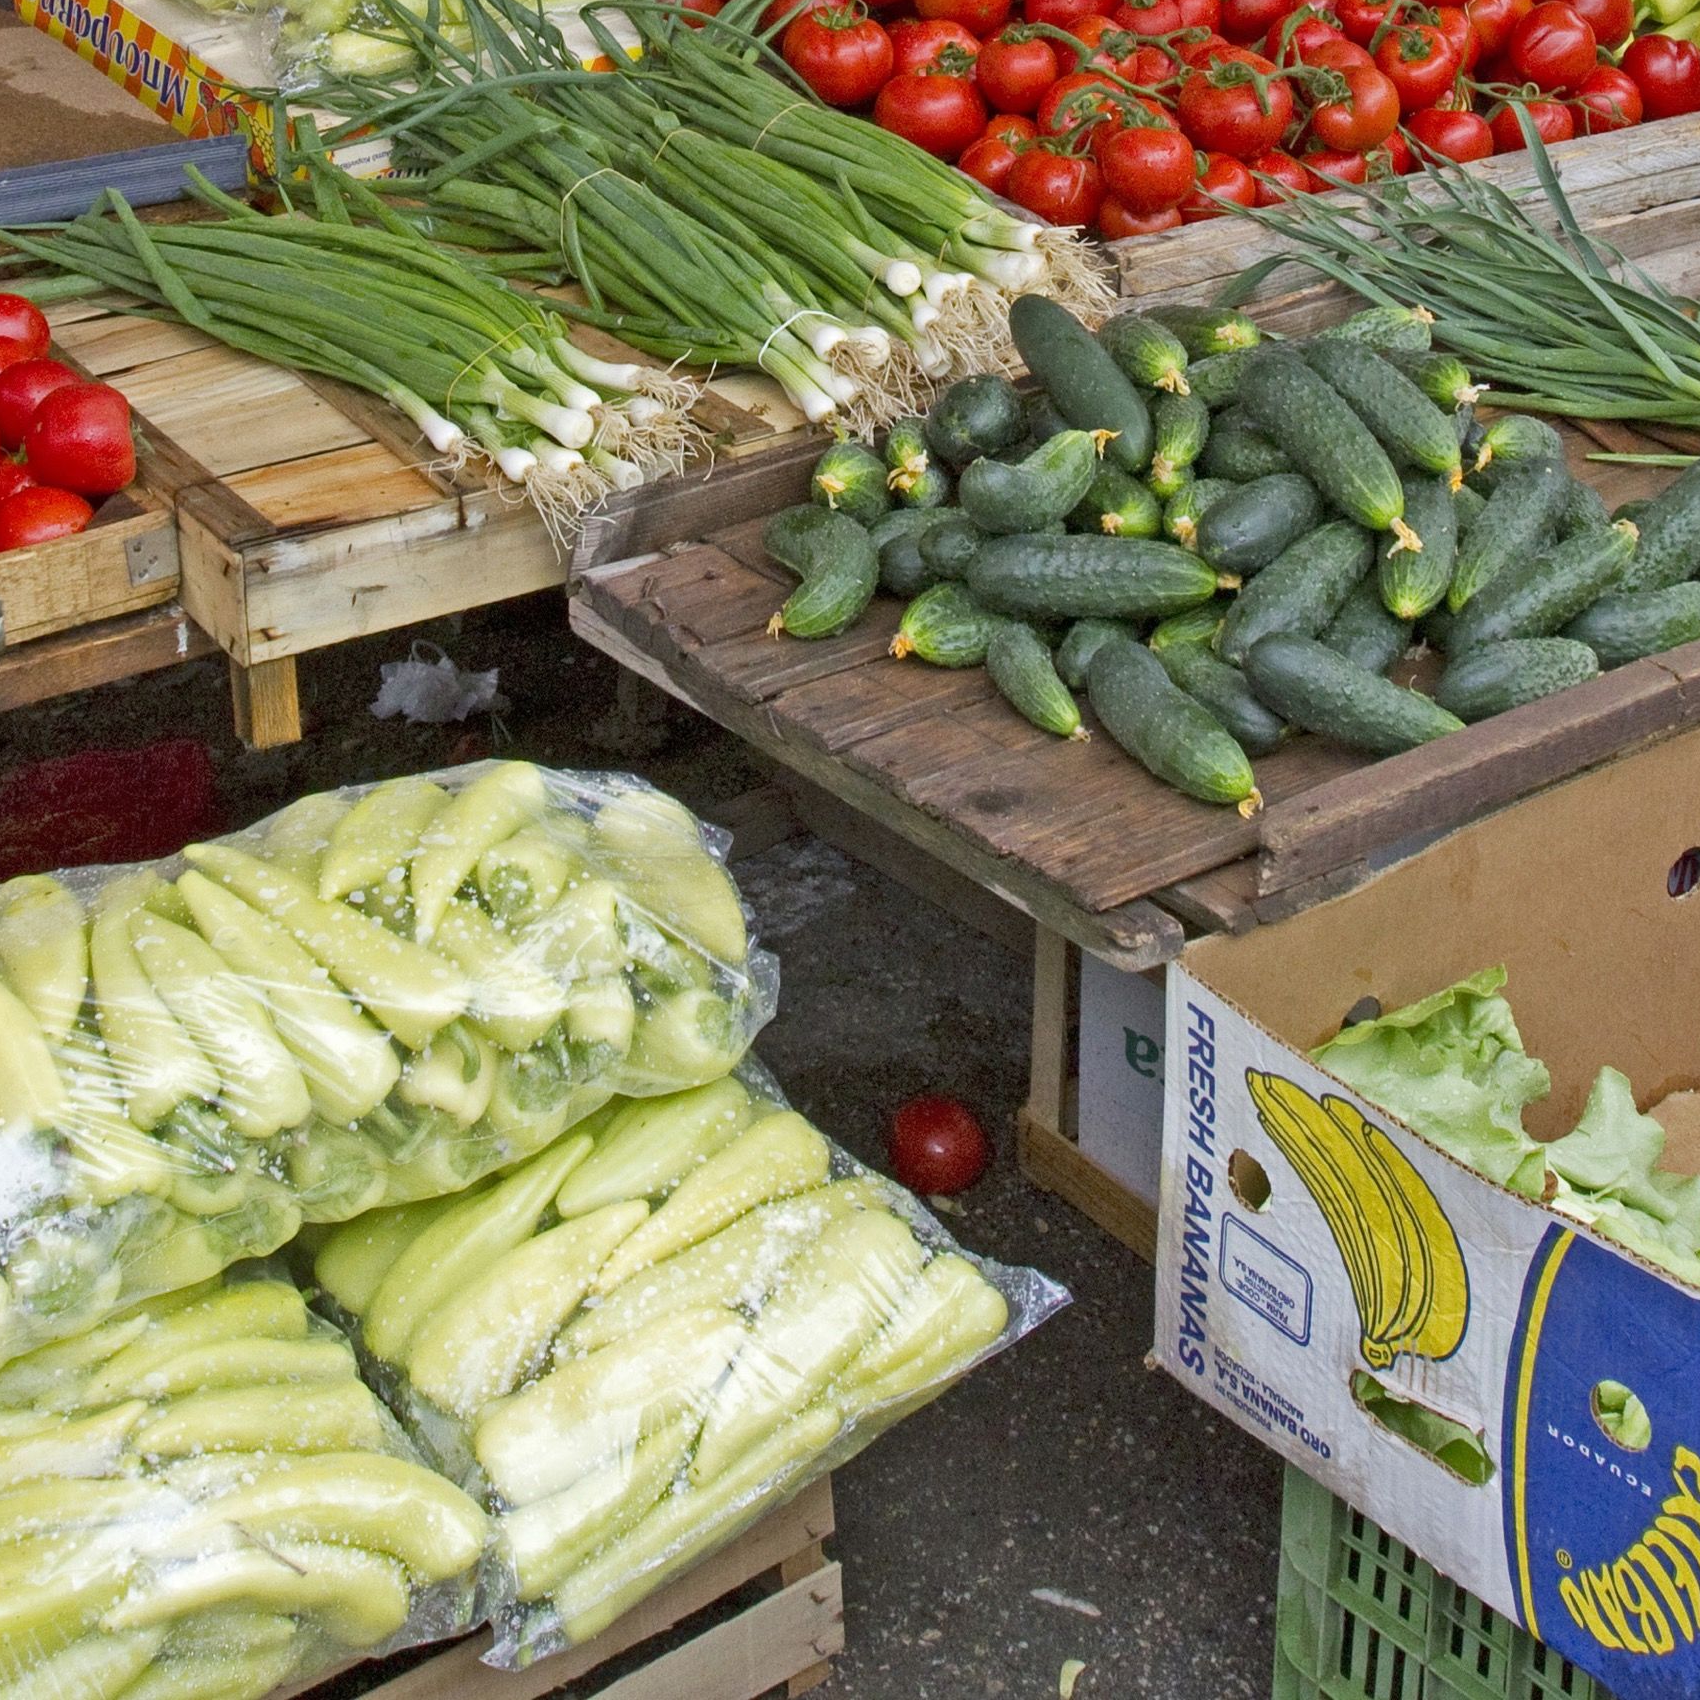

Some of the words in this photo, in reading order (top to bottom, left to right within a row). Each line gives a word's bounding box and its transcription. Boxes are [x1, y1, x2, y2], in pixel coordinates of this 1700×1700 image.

[1186, 1001, 1215, 1158] FRESH
[1177, 1155, 1214, 1377] BANANAS
[1247, 1266, 1278, 1296] BANANA
[1266, 1301, 1289, 1326] FARM
[1277, 1291, 1296, 1310] ORO
[1213, 1360, 1239, 1391] S.A.
[1214, 1345, 1256, 1385] ECUADOR
[1226, 1390, 1273, 1432] PRODUCED
[1240, 1381, 1298, 1437] BANANA
[1260, 1382, 1305, 1423] MACHALA
[1299, 1426, 1332, 1460] ORO
[1546, 1421, 1653, 1499] ECUADOR
